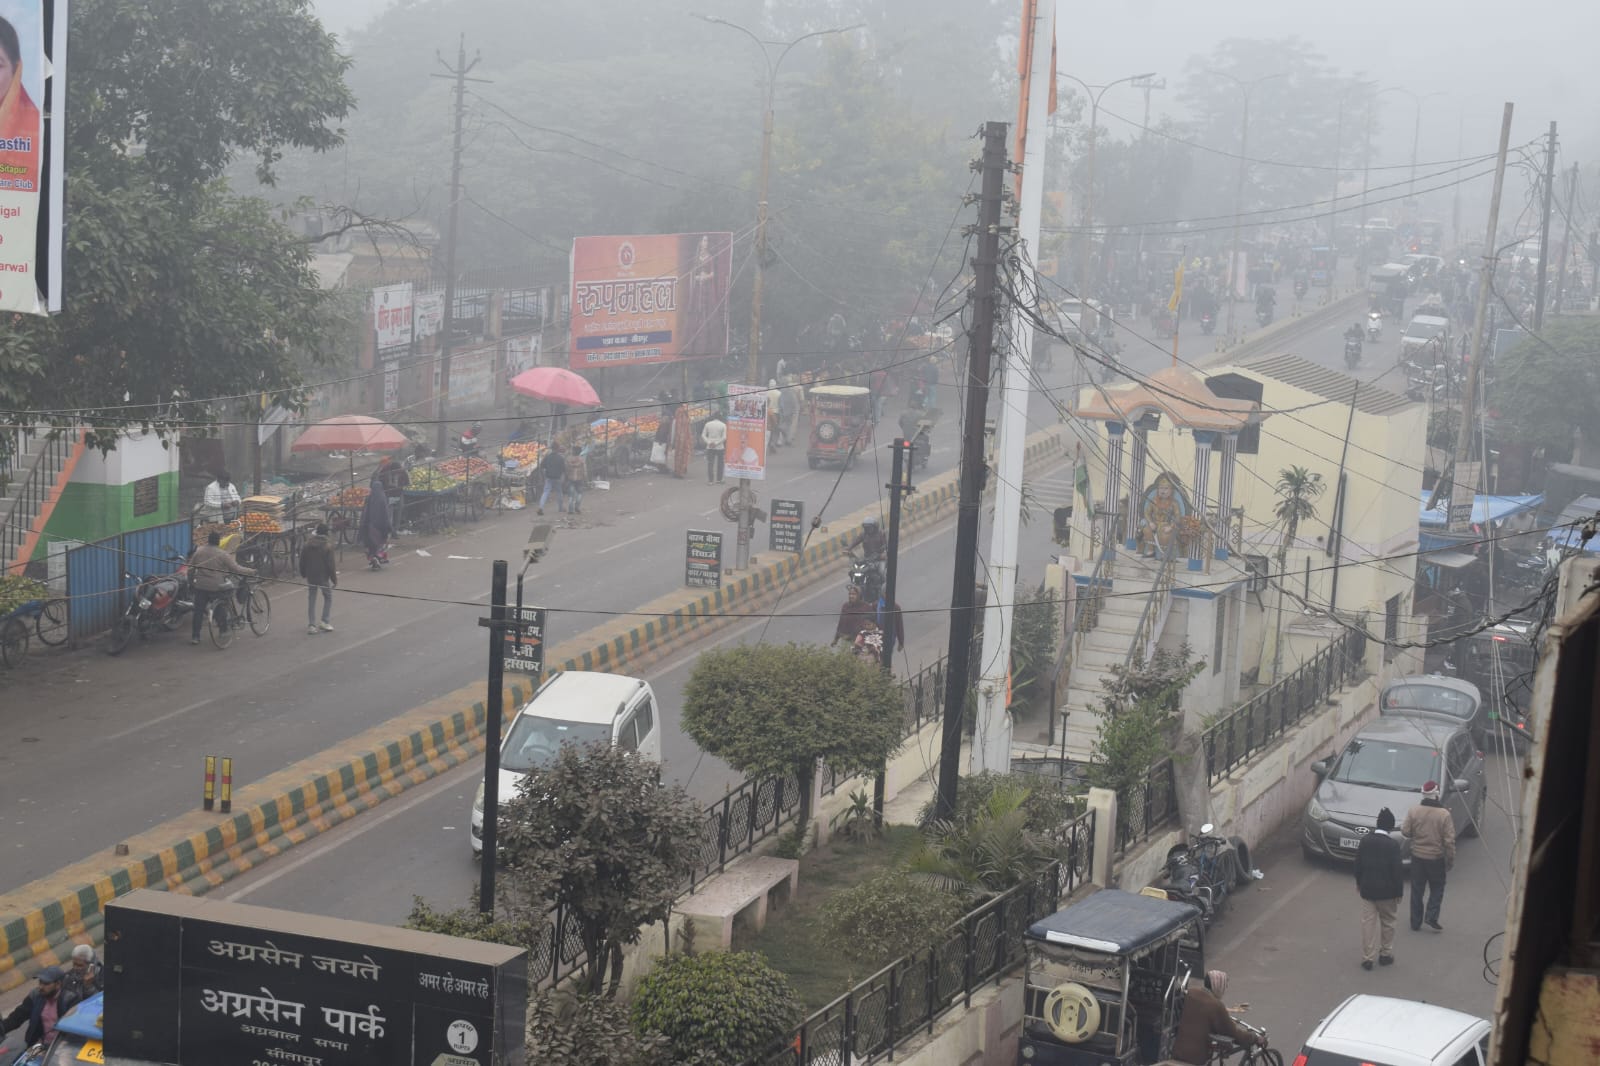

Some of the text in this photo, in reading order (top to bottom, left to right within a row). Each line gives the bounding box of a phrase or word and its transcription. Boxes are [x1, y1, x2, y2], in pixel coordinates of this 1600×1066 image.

[208, 940, 382, 981] अग्रसेन जयते
[419, 972, 489, 999] अमर रहे अमर रहे
[200, 986, 386, 1040] अग्रसेन पार्क
[313, 1038, 349, 1051] सभा
[458, 1031, 465, 1044] 1
[265, 1047, 323, 1066] सीतापुर
